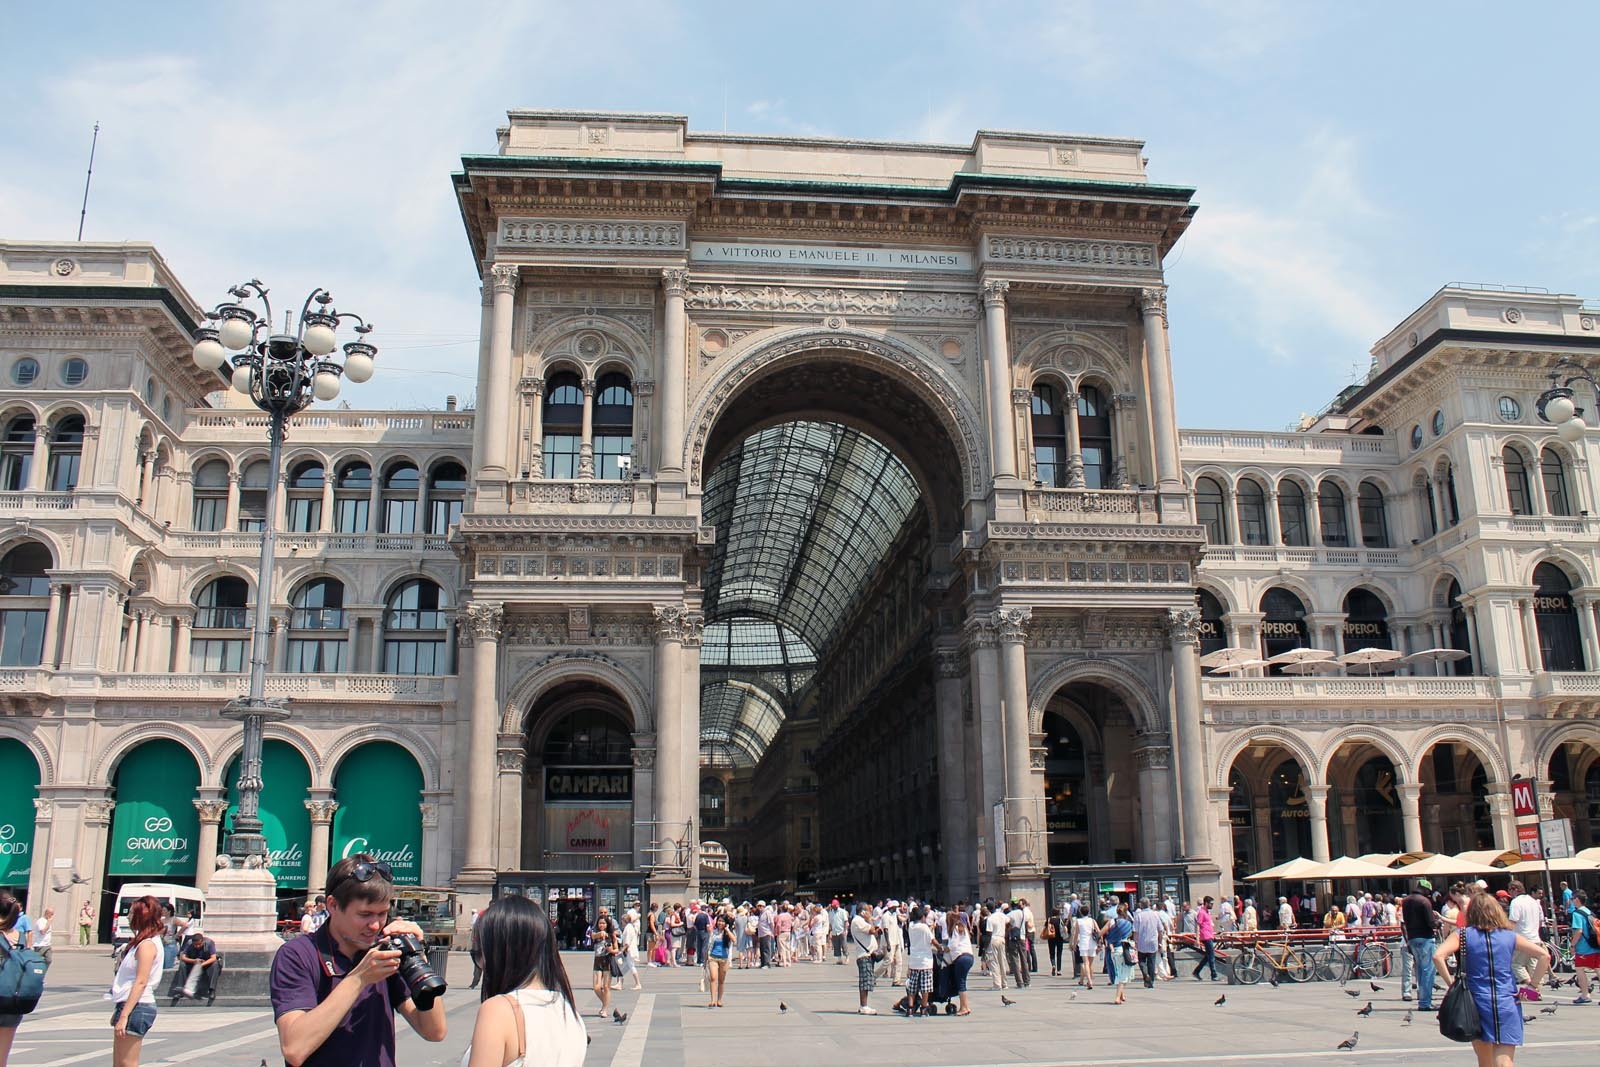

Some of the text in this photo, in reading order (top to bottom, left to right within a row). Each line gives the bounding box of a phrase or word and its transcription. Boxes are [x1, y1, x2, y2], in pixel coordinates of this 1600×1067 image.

[705, 247, 713, 256] A
[722, 247, 782, 258] VITTORIO
[789, 249, 860, 261] EMANUELE
[888, 253, 893, 263] I
[900, 253, 959, 265] MILANESI
[1260, 620, 1300, 634] APEROL
[1343, 621, 1382, 634] APEROL
[549, 775, 629, 793] CAMPARI
[1514, 787, 1533, 810] M
[126, 837, 188, 850] GRIMOLDI
[570, 838, 606, 847] CAMPARI
